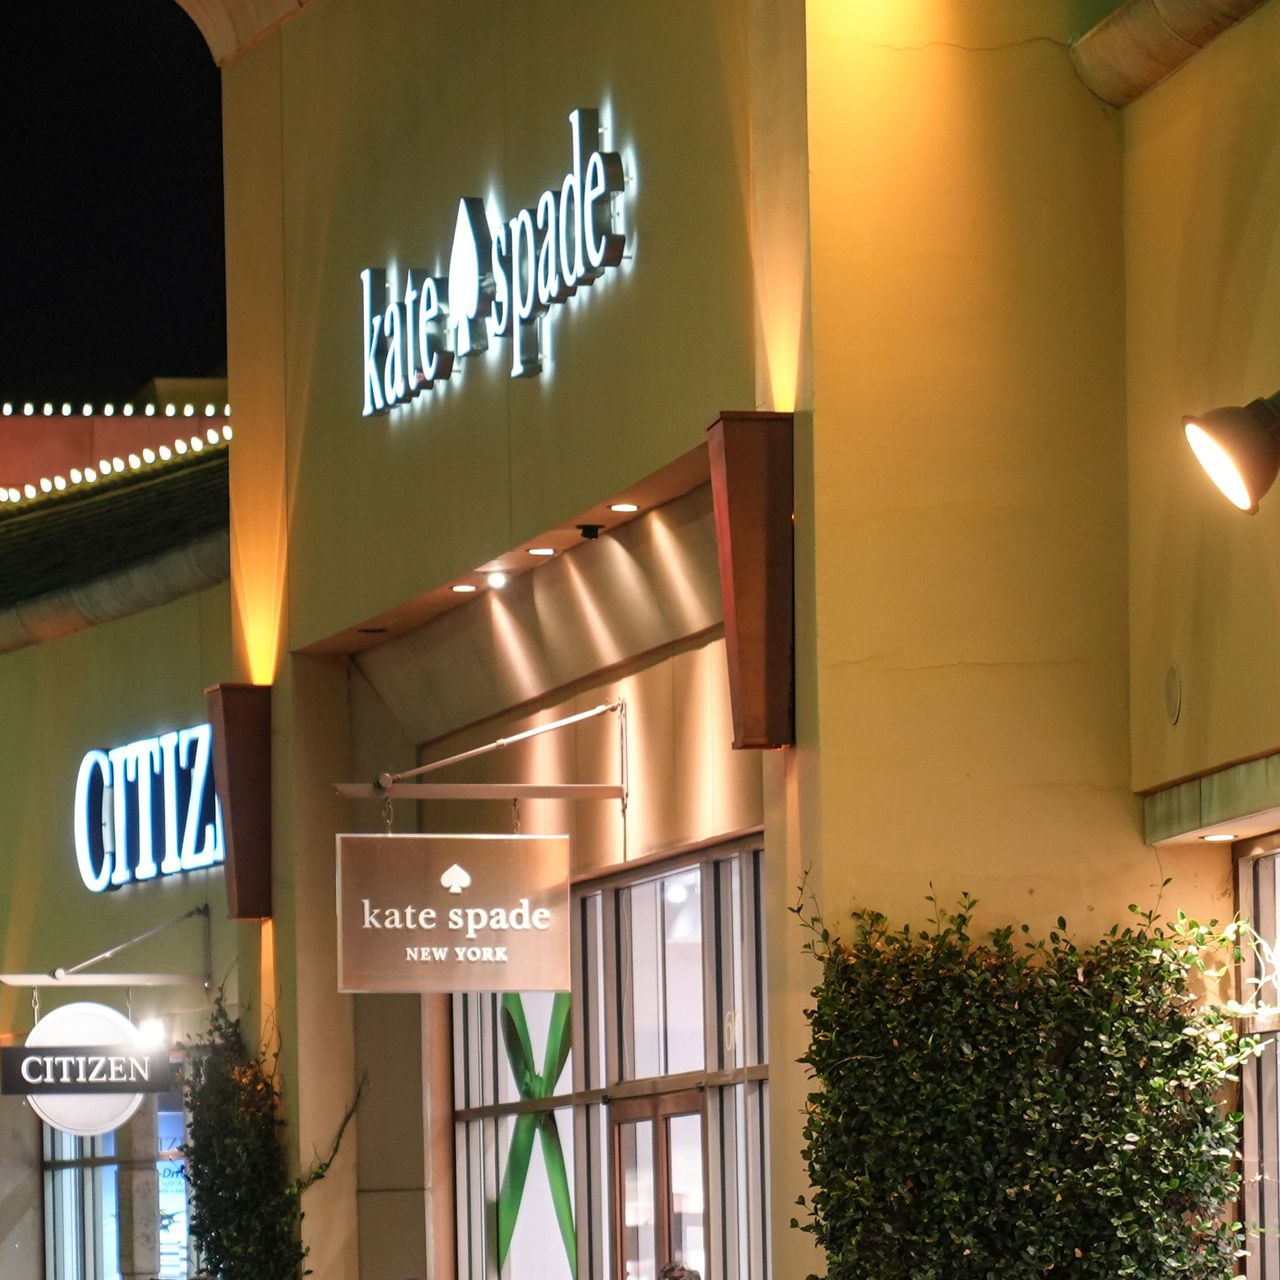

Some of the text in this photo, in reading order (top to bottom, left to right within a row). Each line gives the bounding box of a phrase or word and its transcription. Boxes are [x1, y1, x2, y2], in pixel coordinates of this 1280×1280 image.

[361, 108, 617, 417] kate spade
[74, 723, 226, 893] CITIZ
[361, 898, 551, 938] kate spade
[405, 946, 509, 962] NEW YORK
[20, 1056, 152, 1085] CITIZEN
